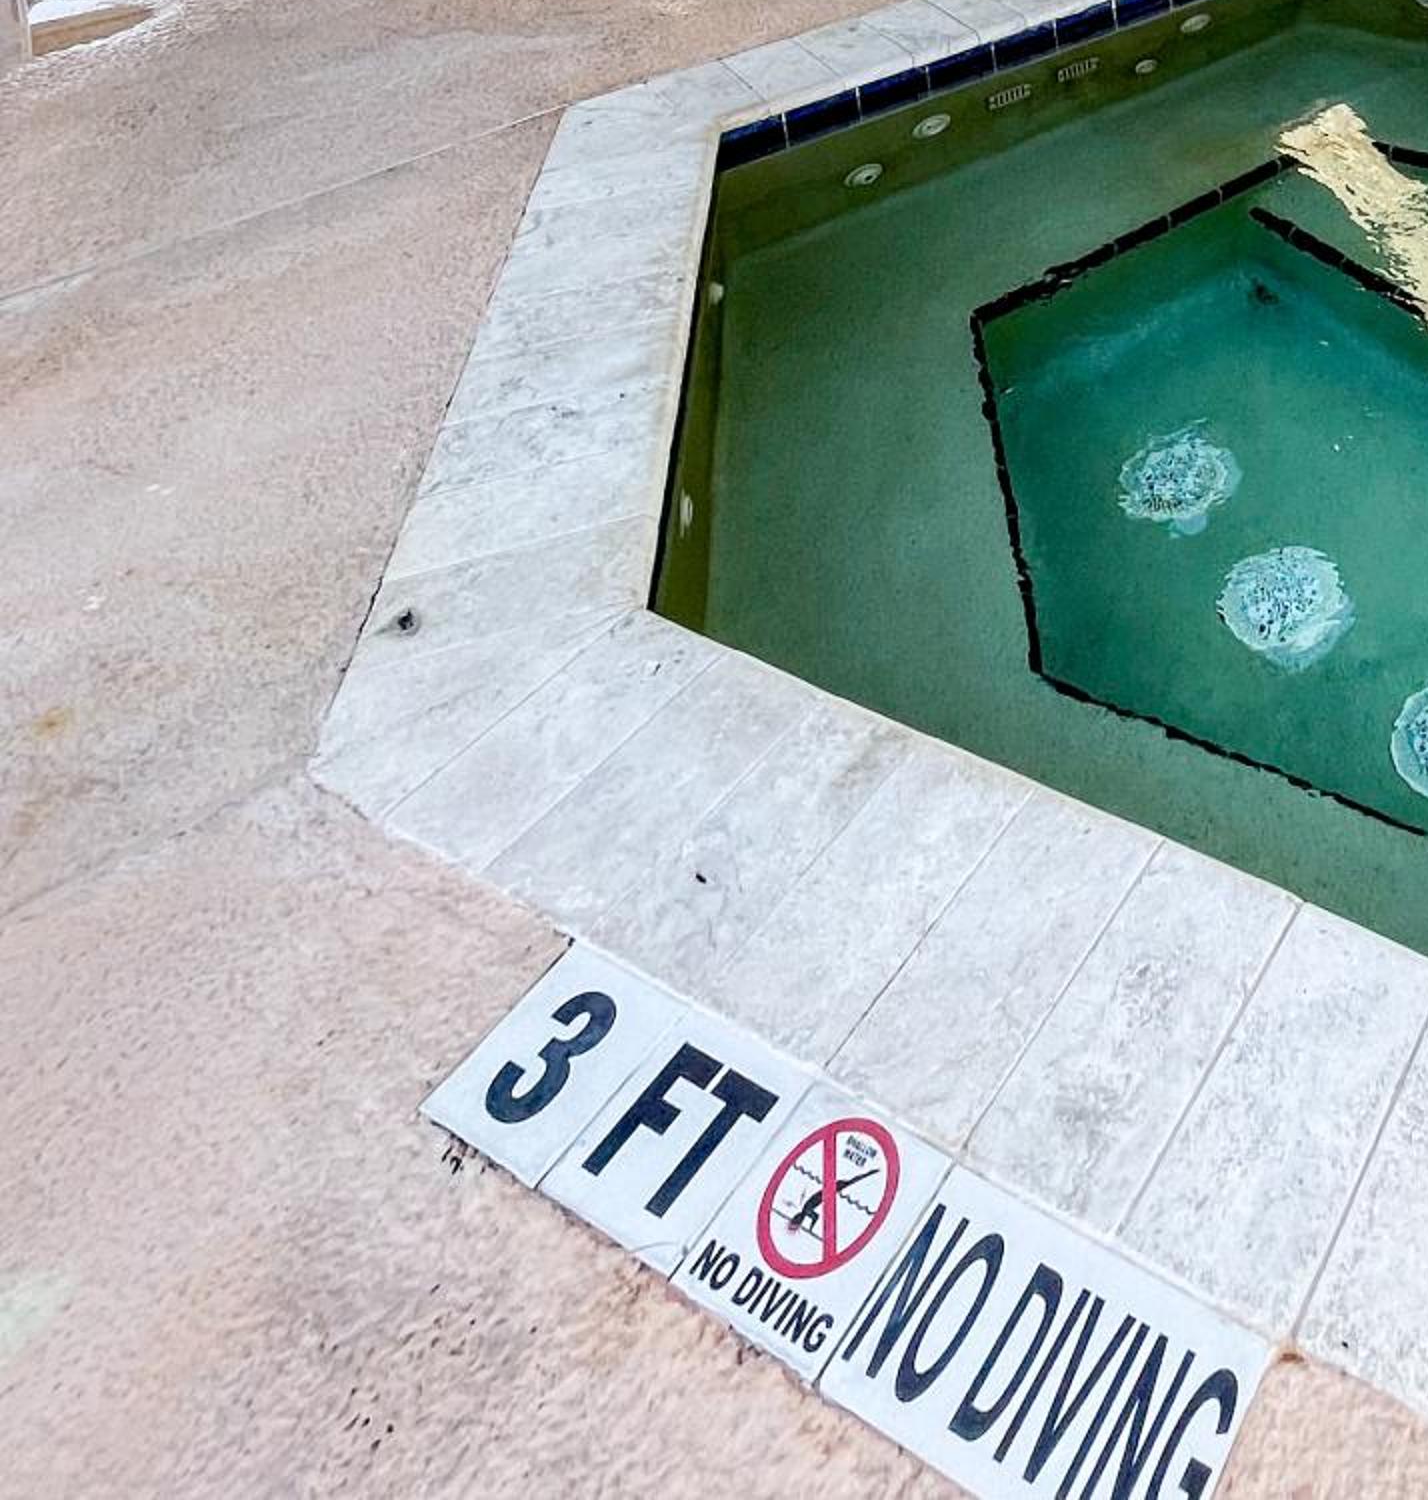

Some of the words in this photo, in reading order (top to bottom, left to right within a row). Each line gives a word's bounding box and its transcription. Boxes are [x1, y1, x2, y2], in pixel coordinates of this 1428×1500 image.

[485, 991, 617, 1124] 3
[581, 1042, 779, 1218] FT
[688, 1239, 741, 1291] NO
[731, 1266, 834, 1353] DIVING
[841, 1203, 1005, 1403] NO
[948, 1263, 1239, 1500] DIVING
